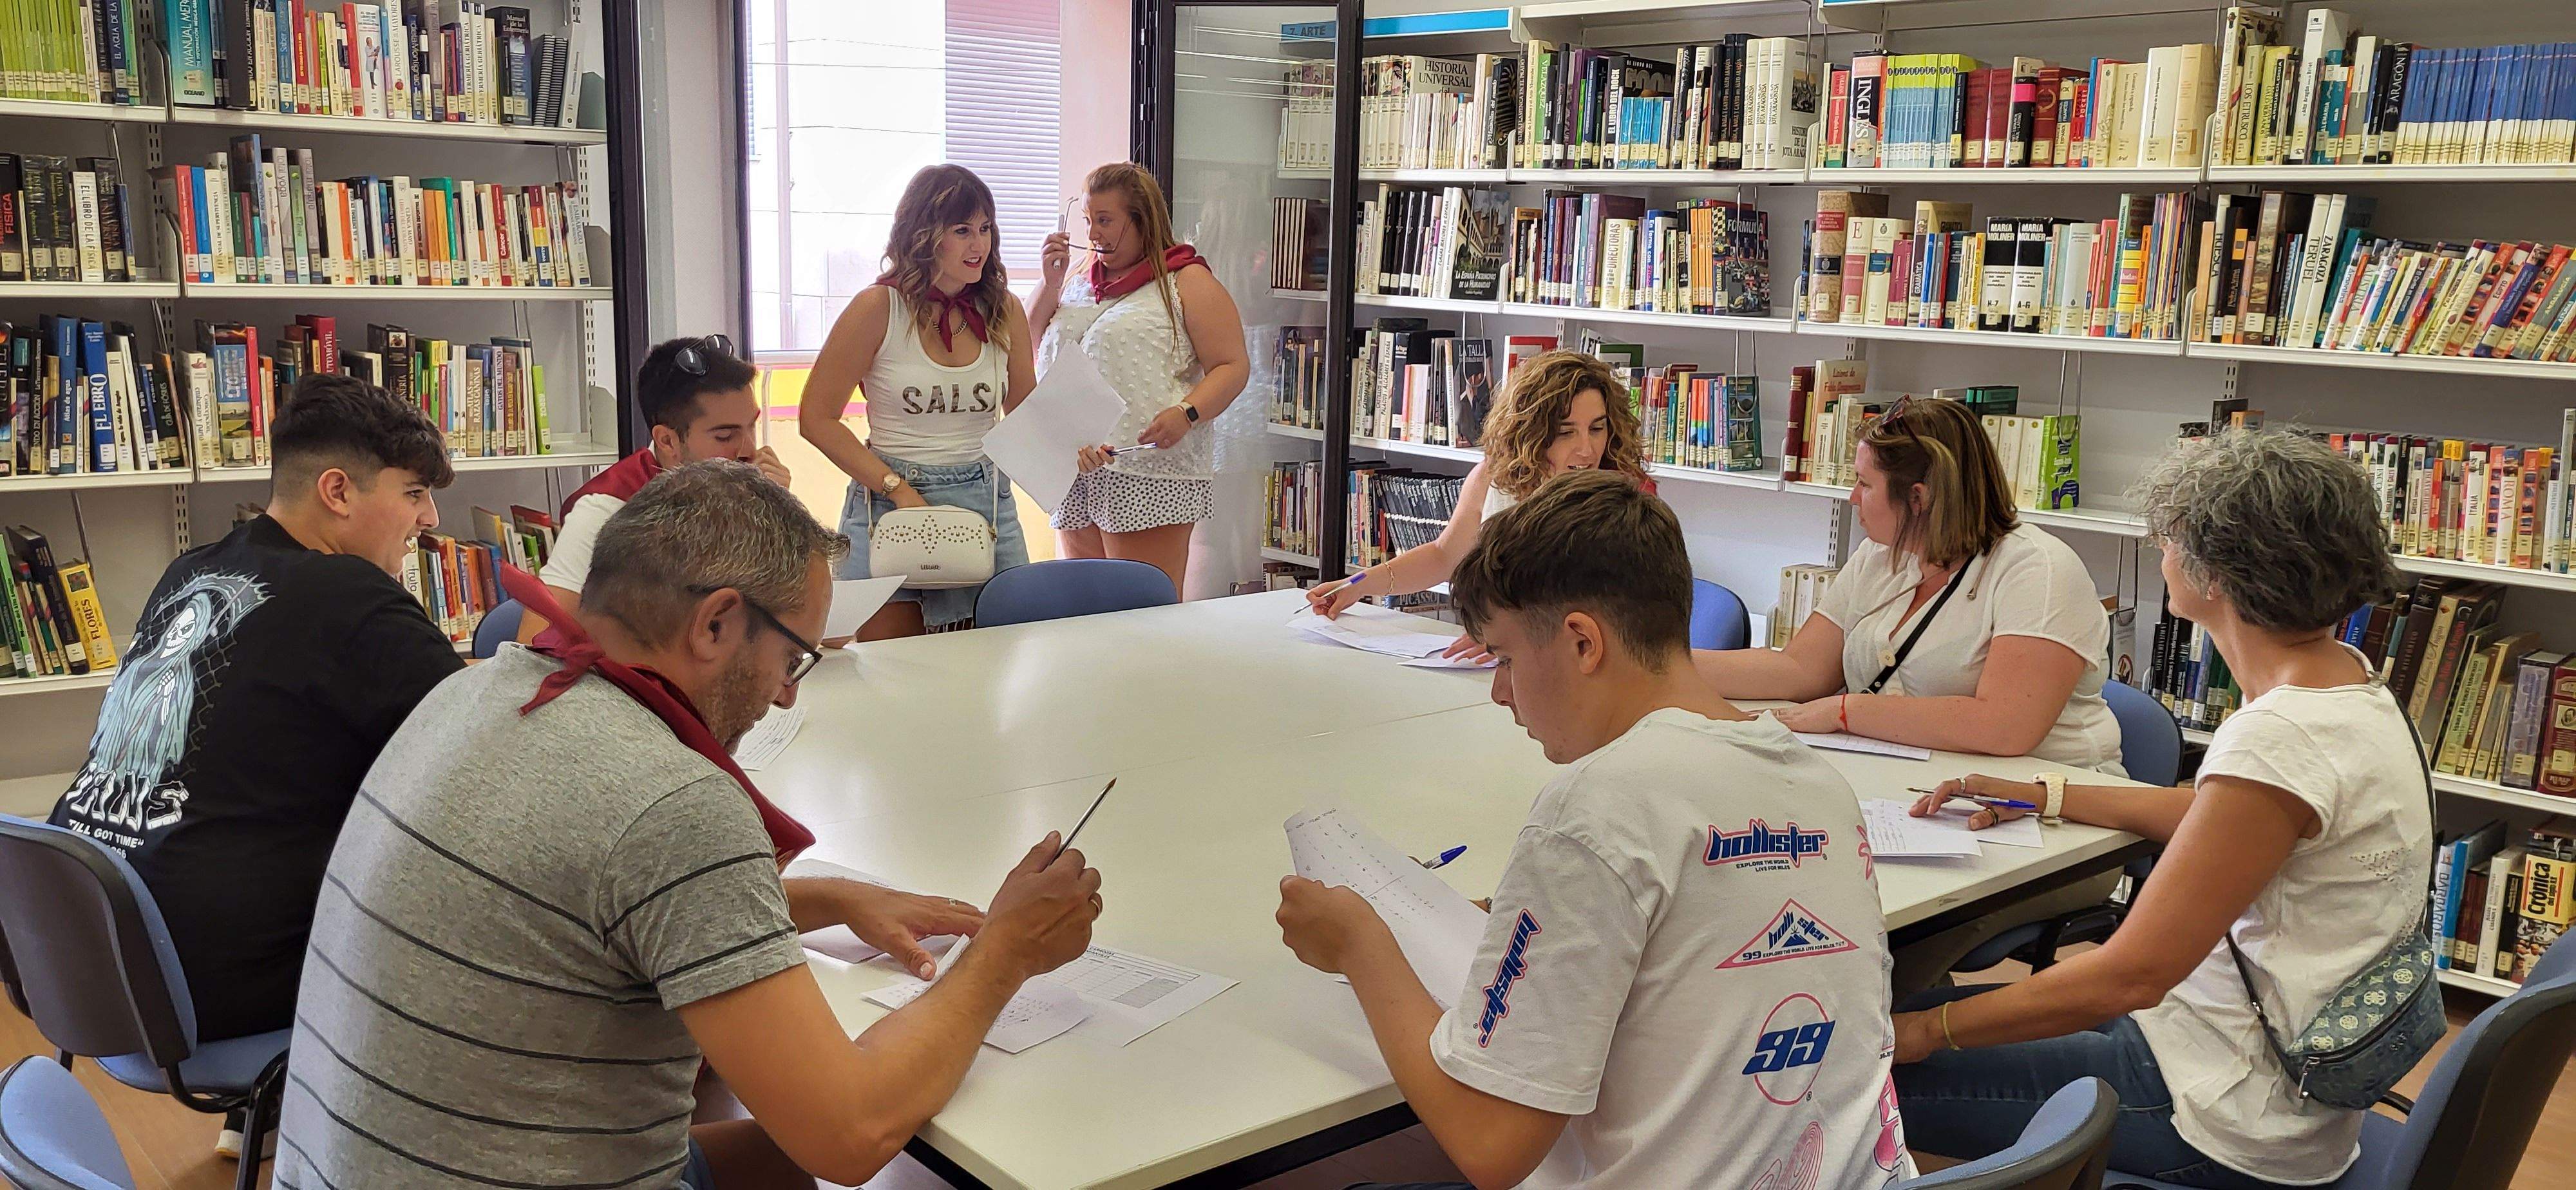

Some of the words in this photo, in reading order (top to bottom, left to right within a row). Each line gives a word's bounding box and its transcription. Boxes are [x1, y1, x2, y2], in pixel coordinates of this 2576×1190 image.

[110, 13, 119, 24] DE
[1301, 25, 1326, 36] ARTE
[180, 23, 194, 67] MANUAL
[393, 39, 402, 77] LAROUSSE
[1424, 60, 1468, 75] HISTORIA
[1419, 73, 1473, 88] UNIVERSAL
[1539, 59, 1548, 109] VELAZQUEZ
[1611, 68, 1620, 90] ROCK
[2244, 83, 2254, 99] LOS
[1609, 104, 1617, 126] LIBRO
[2320, 101, 2331, 131] ALEMANIA
[1607, 126, 1616, 134] EL
[1782, 146, 1793, 158] JOTA
[1794, 137, 1801, 146] DE
[80, 185, 90, 194] EL
[278, 175, 288, 198] yoga
[82, 196, 93, 220] LIBRO
[84, 221, 93, 232] DE
[1649, 220, 1654, 229] En
[86, 233, 95, 243] LA
[1606, 223, 1621, 269] DIRECTORAS
[1987, 232, 2015, 242] MOLINER
[2018, 232, 2046, 242] MOLINER
[2302, 236, 2321, 284] TERUEL
[2315, 235, 2334, 284] ZARAGOZA
[2350, 265, 2373, 313] AUSTRIA
[2492, 279, 2508, 299] EGIPTO
[90, 373, 108, 411] EBRO
[94, 413, 111, 431] EL
[2468, 495, 2479, 516] ITALIA
[2501, 480, 2515, 520] ROMA
[407, 568, 417, 592] fruta
[80, 598, 101, 640] FLORES
[93, 827, 113, 841] GOT
[1708, 820, 1826, 864] hollister
[2528, 862, 2551, 915] Crónica
[1743, 950, 1762, 959] 99
[1480, 911, 1539, 1044] hollister
[1742, 1020, 1836, 1075] 99
